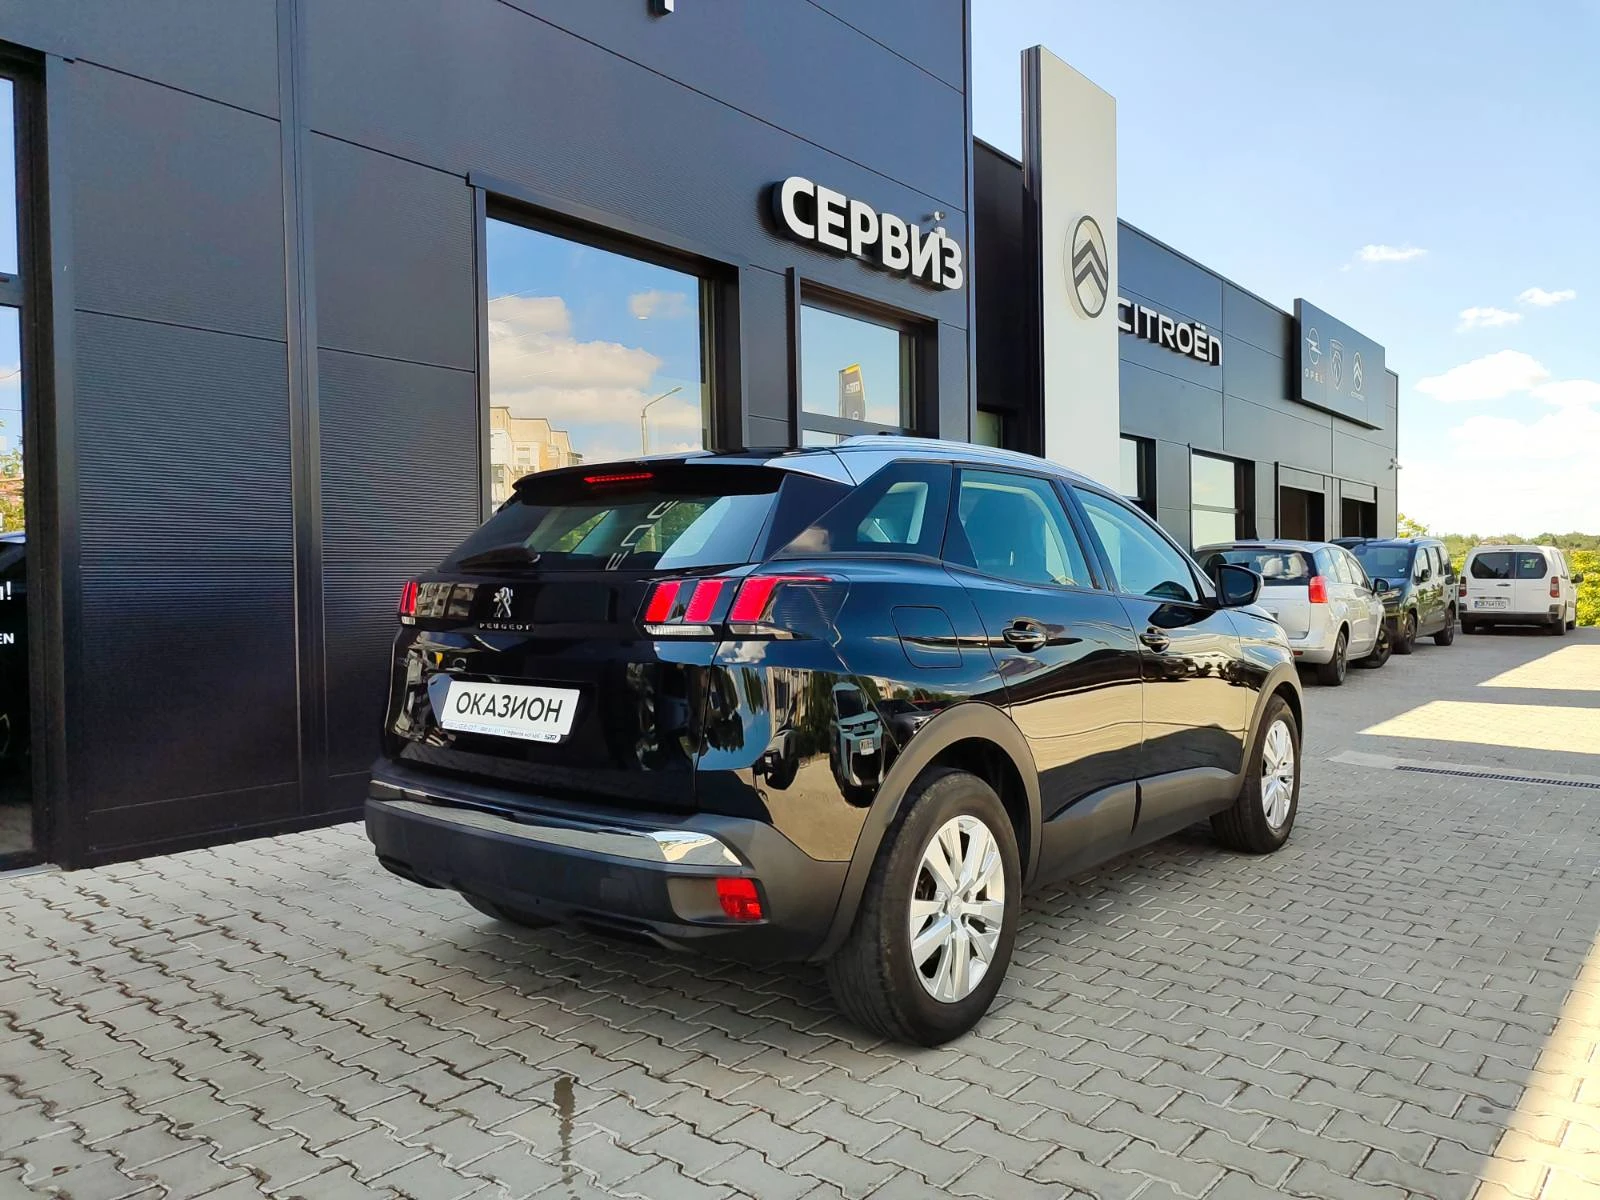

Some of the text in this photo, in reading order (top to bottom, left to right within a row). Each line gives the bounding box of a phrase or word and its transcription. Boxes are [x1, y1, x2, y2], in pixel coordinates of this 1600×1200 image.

[781, 176, 963, 290] СЕРВИЗ
[480, 622, 533, 631] PEUGEOT
[456, 691, 563, 723] ОКАЗИОН
